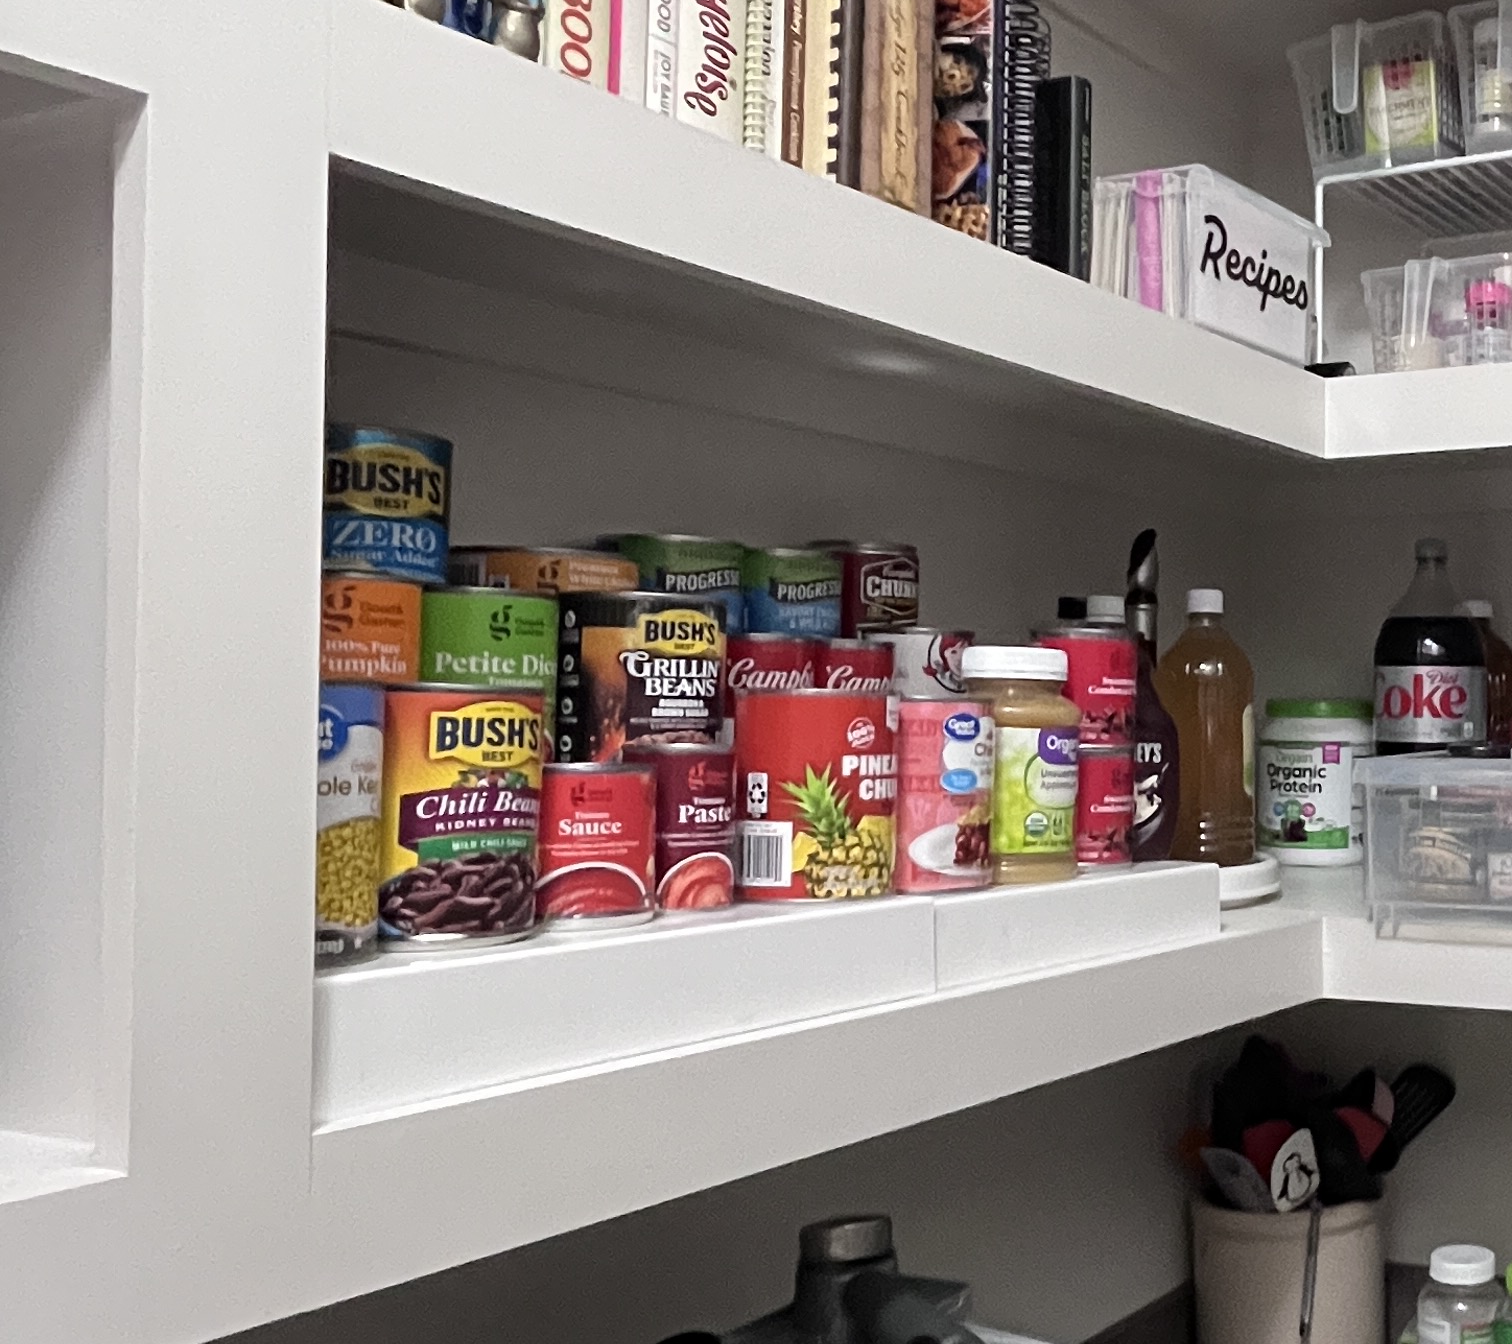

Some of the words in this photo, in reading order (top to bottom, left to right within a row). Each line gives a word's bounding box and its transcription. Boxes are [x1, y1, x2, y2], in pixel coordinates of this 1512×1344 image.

[1199, 214, 1309, 312] Recipes
[324, 458, 442, 506] BUSH'S
[373, 496, 409, 510] BEST
[331, 519, 437, 554] ZERO
[644, 620, 716, 646] BUSH'S
[322, 655, 407, 677] umpkin
[435, 650, 517, 675] Petite
[644, 678, 716, 697] BEANS
[436, 715, 540, 753] BUSH'S
[481, 749, 514, 763] BEST
[1266, 763, 1327, 781] Organic
[1269, 779, 1323, 794] Protein
[415, 790, 488, 820] Chili
[677, 804, 732, 824] Paste
[434, 817, 498, 832] KIDNEY
[558, 818, 623, 837] Sauce
